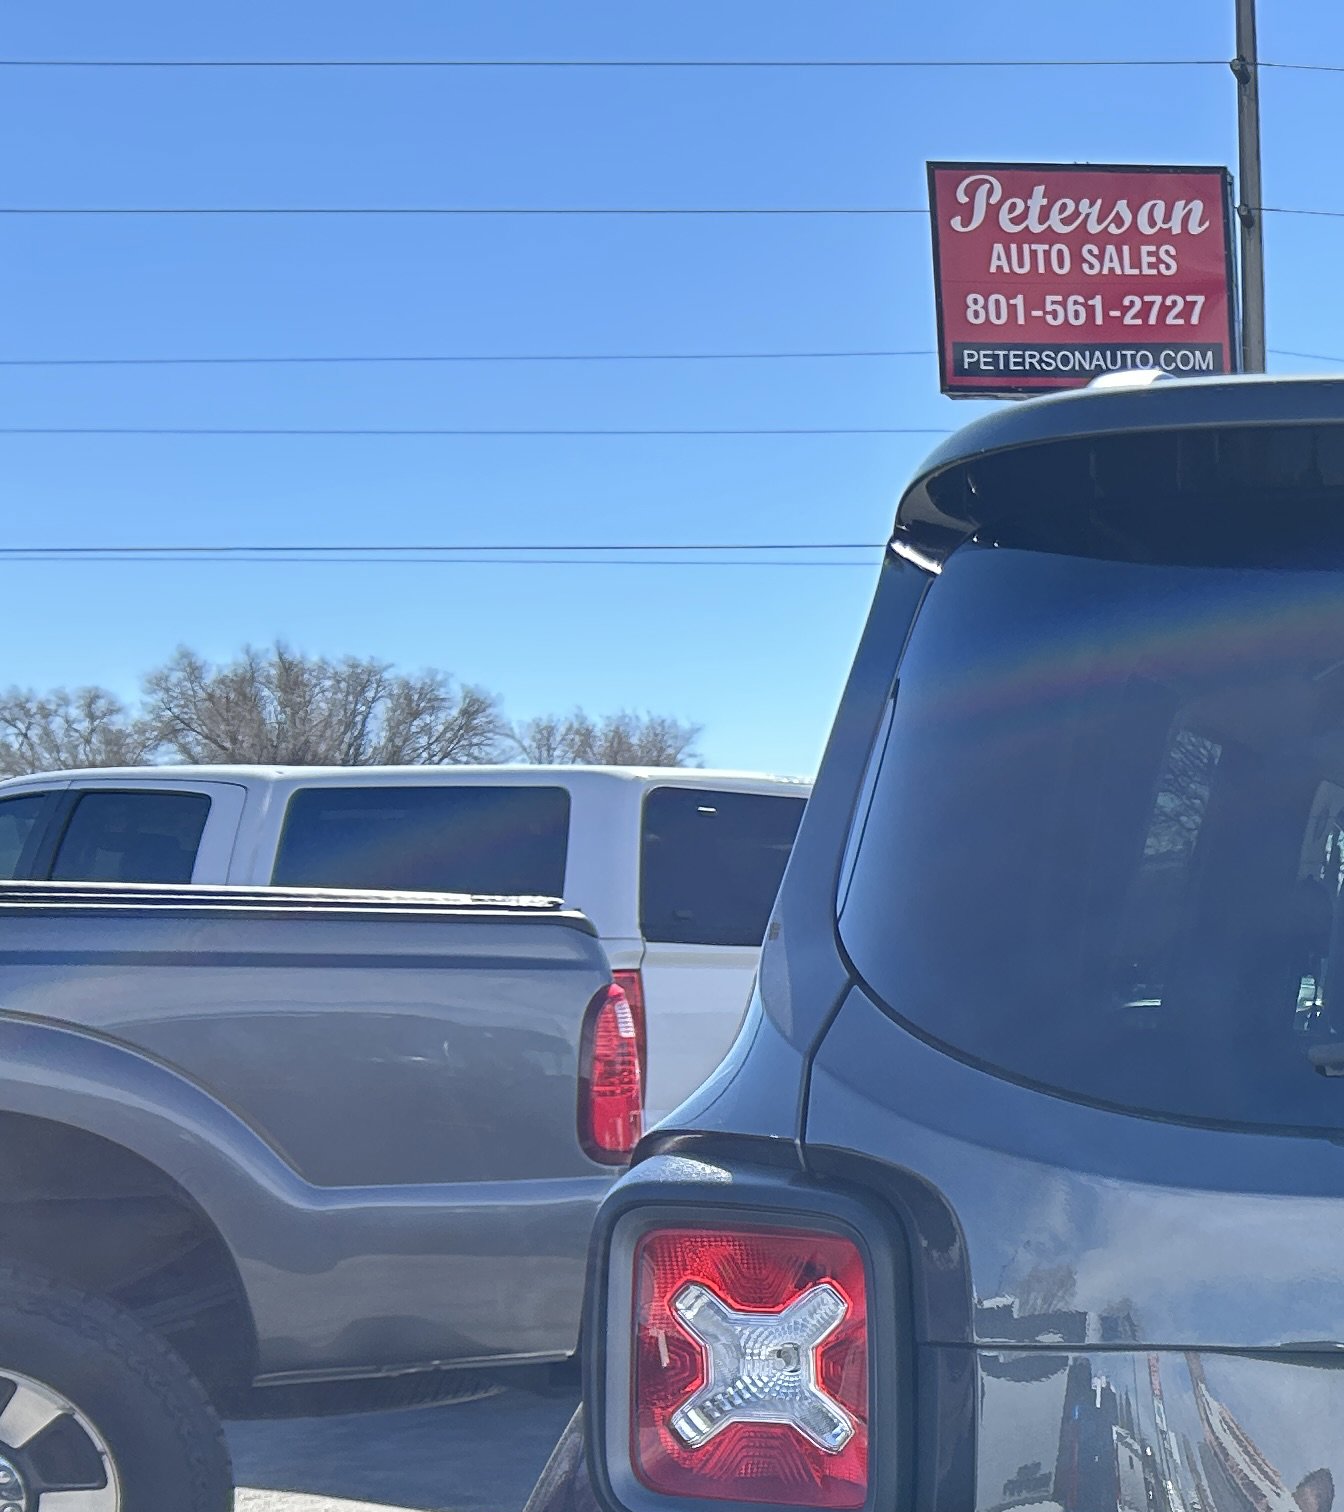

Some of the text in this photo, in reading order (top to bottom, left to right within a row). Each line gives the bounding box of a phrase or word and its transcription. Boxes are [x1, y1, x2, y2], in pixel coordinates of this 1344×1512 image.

[951, 174, 1210, 235] Peterson
[989, 243, 1178, 276] AUTO SALES
[965, 294, 1206, 326] 801-561-2727
